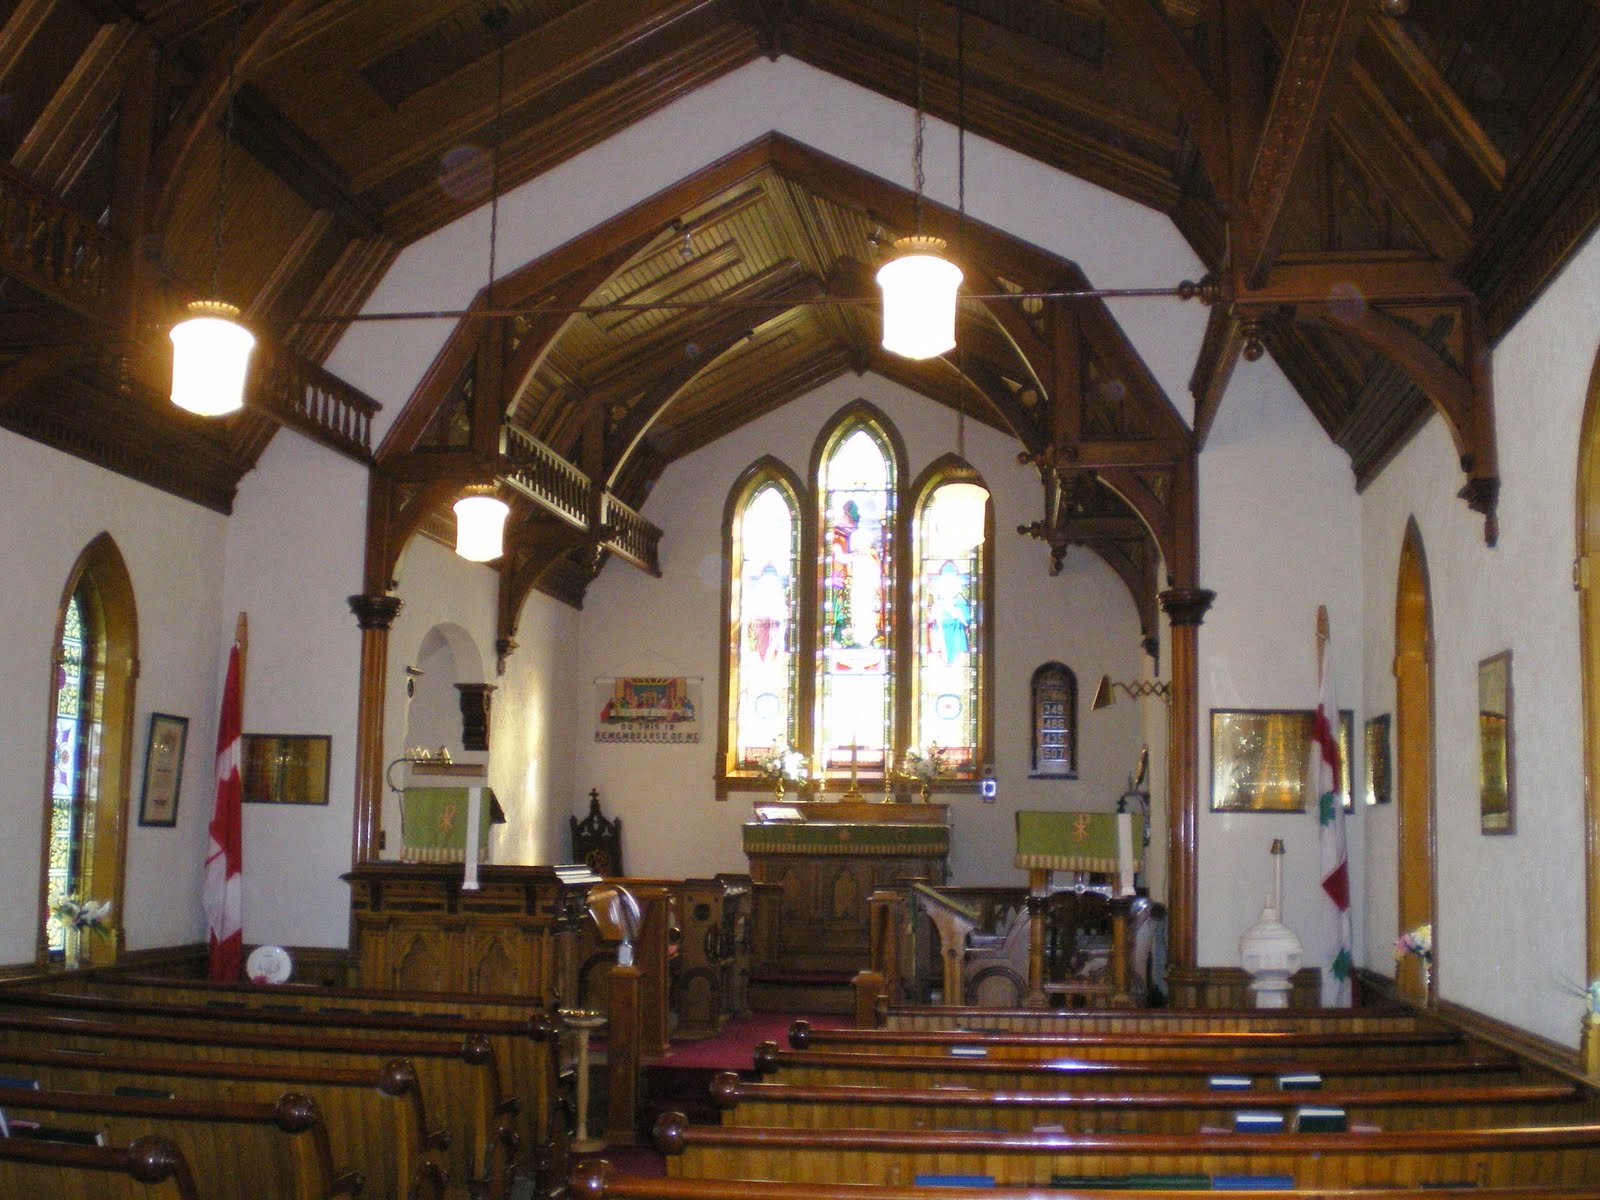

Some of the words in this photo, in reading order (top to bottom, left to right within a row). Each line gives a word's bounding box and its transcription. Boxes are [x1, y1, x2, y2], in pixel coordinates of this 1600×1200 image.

[621, 723, 633, 731] DO
[638, 723, 660, 731] THIS
[665, 723, 675, 731] IN
[595, 732, 668, 740] REMEMBRANCE
[671, 732, 682, 740] OF
[686, 732, 699, 740] ME
